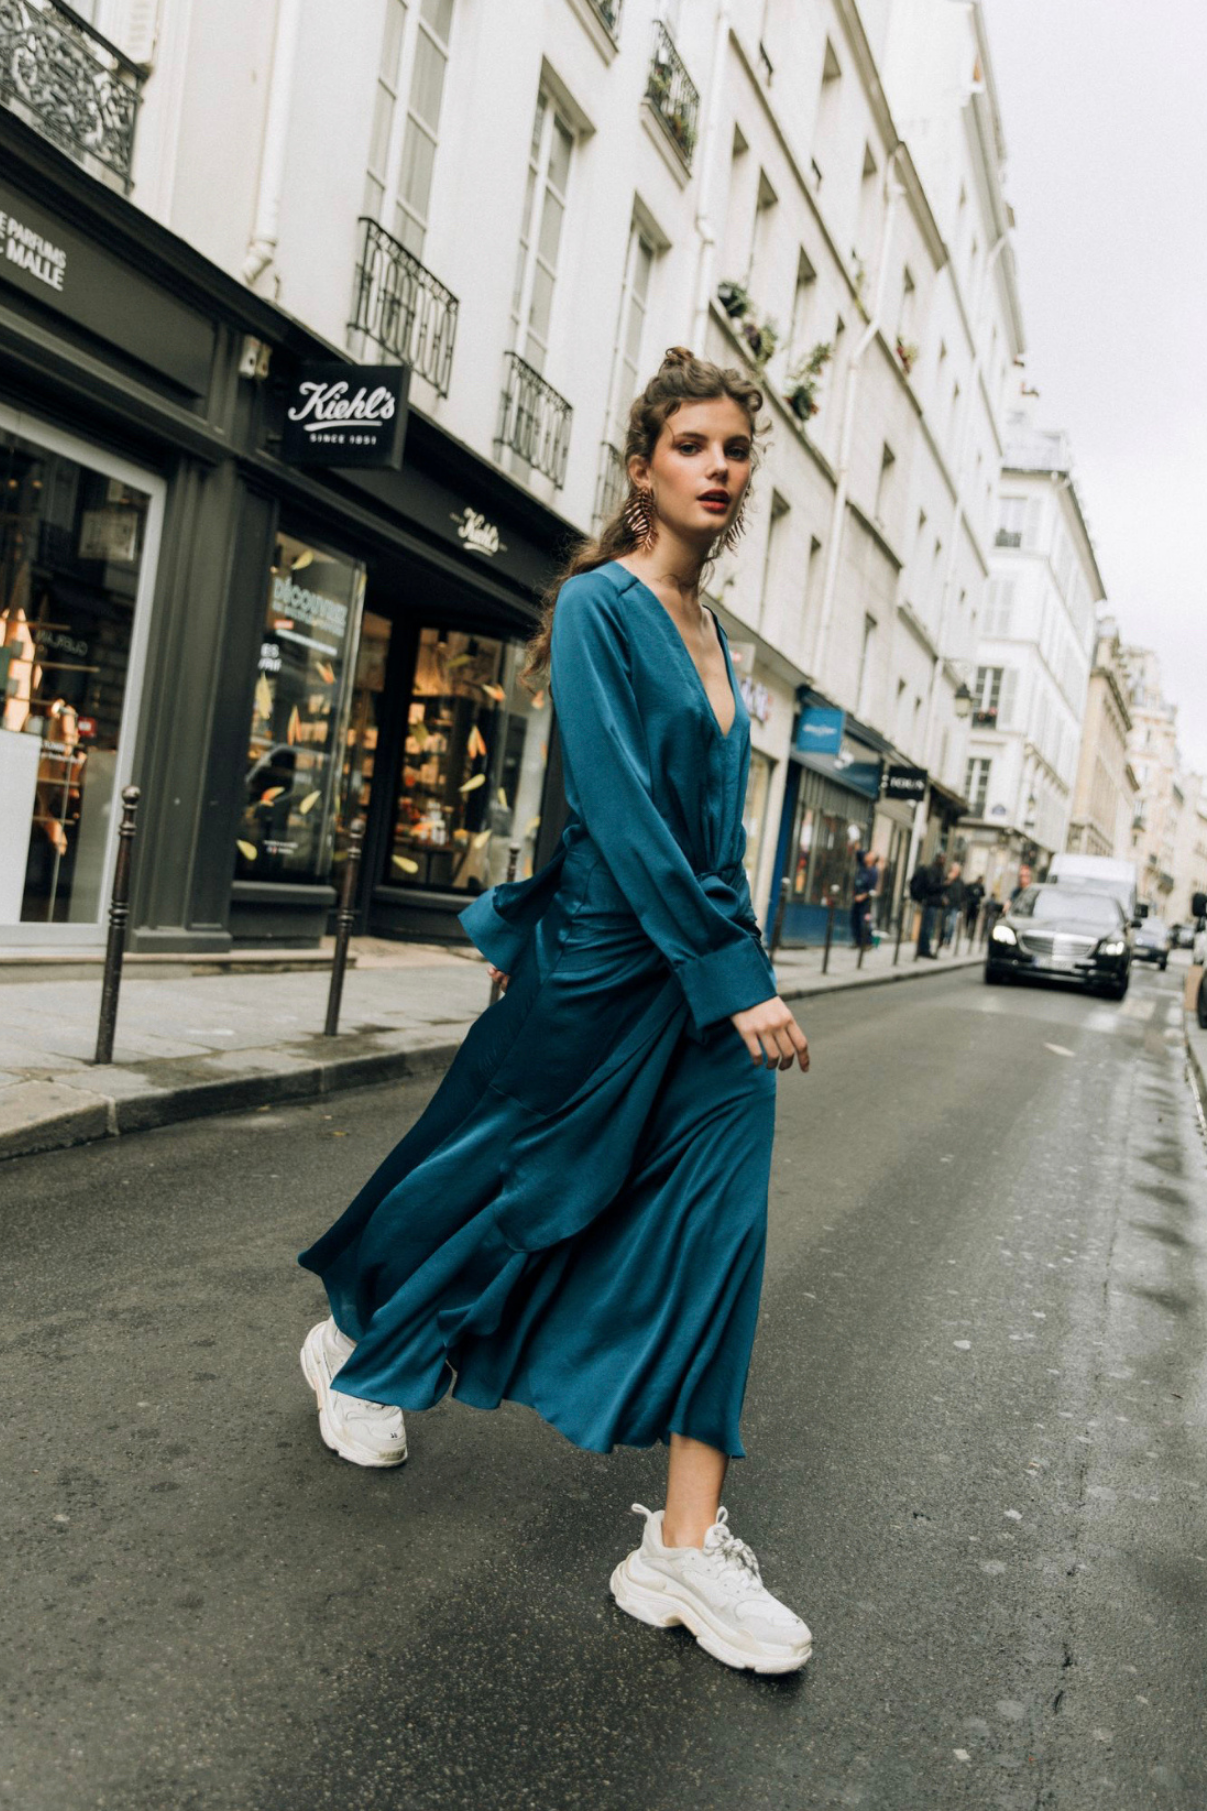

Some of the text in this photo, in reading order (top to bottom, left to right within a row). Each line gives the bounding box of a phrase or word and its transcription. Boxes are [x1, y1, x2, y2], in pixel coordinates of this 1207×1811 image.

[6, 217, 67, 269] PARFUMS
[6, 237, 65, 292] MALLE
[288, 381, 395, 421] Kiehl's
[309, 433, 345, 444] SINCE
[458, 507, 499, 553] Kiehl's
